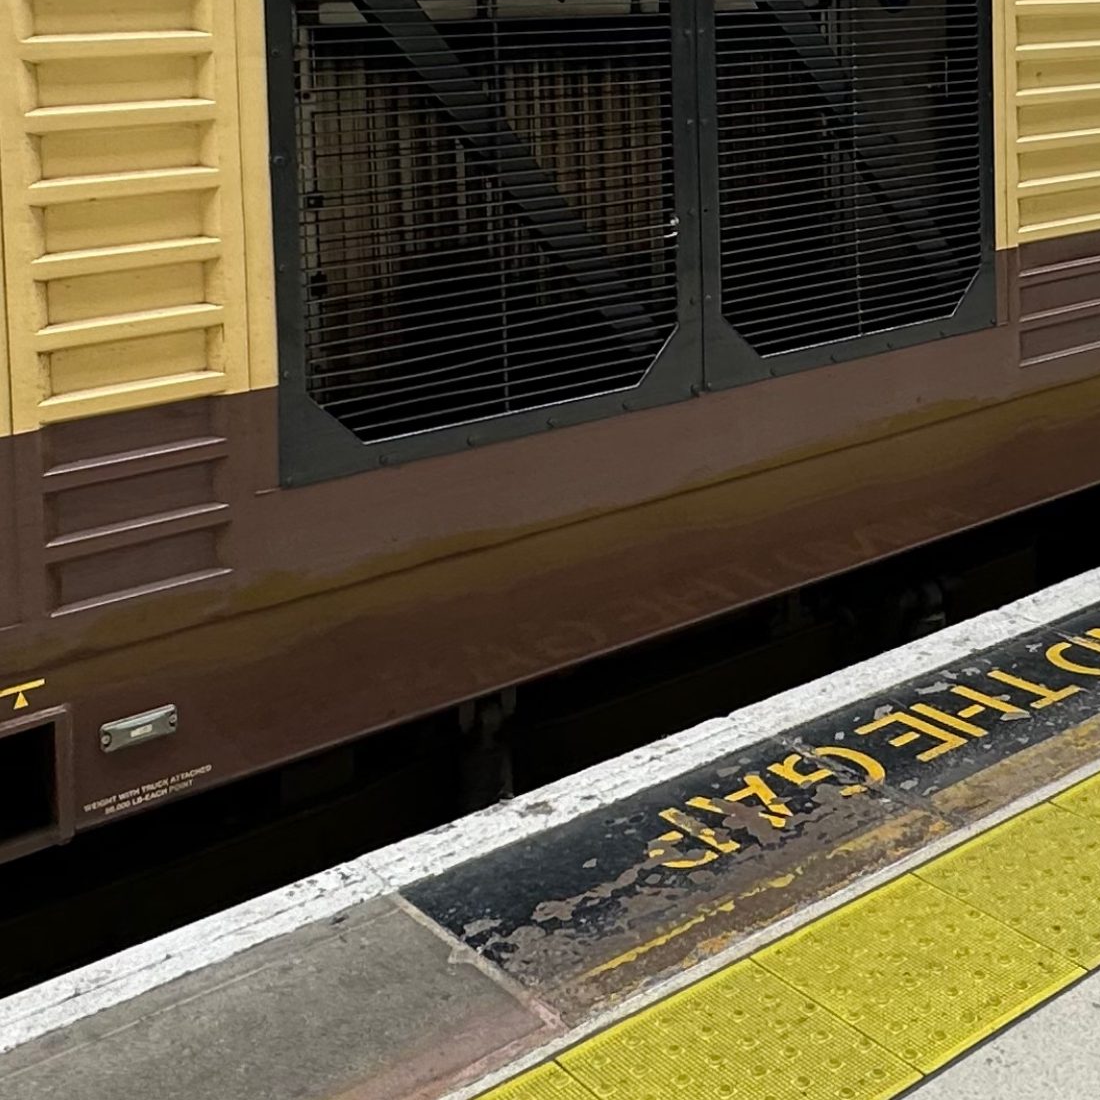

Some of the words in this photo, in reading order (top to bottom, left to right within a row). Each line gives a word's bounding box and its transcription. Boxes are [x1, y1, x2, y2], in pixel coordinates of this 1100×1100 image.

[853, 668, 1090, 762] THE
[118, 788, 140, 800] WITH
[141, 778, 169, 793] TRUCK
[170, 764, 212, 784] ATTACHED
[169, 779, 193, 793] POINT
[646, 745, 887, 869] GAP
